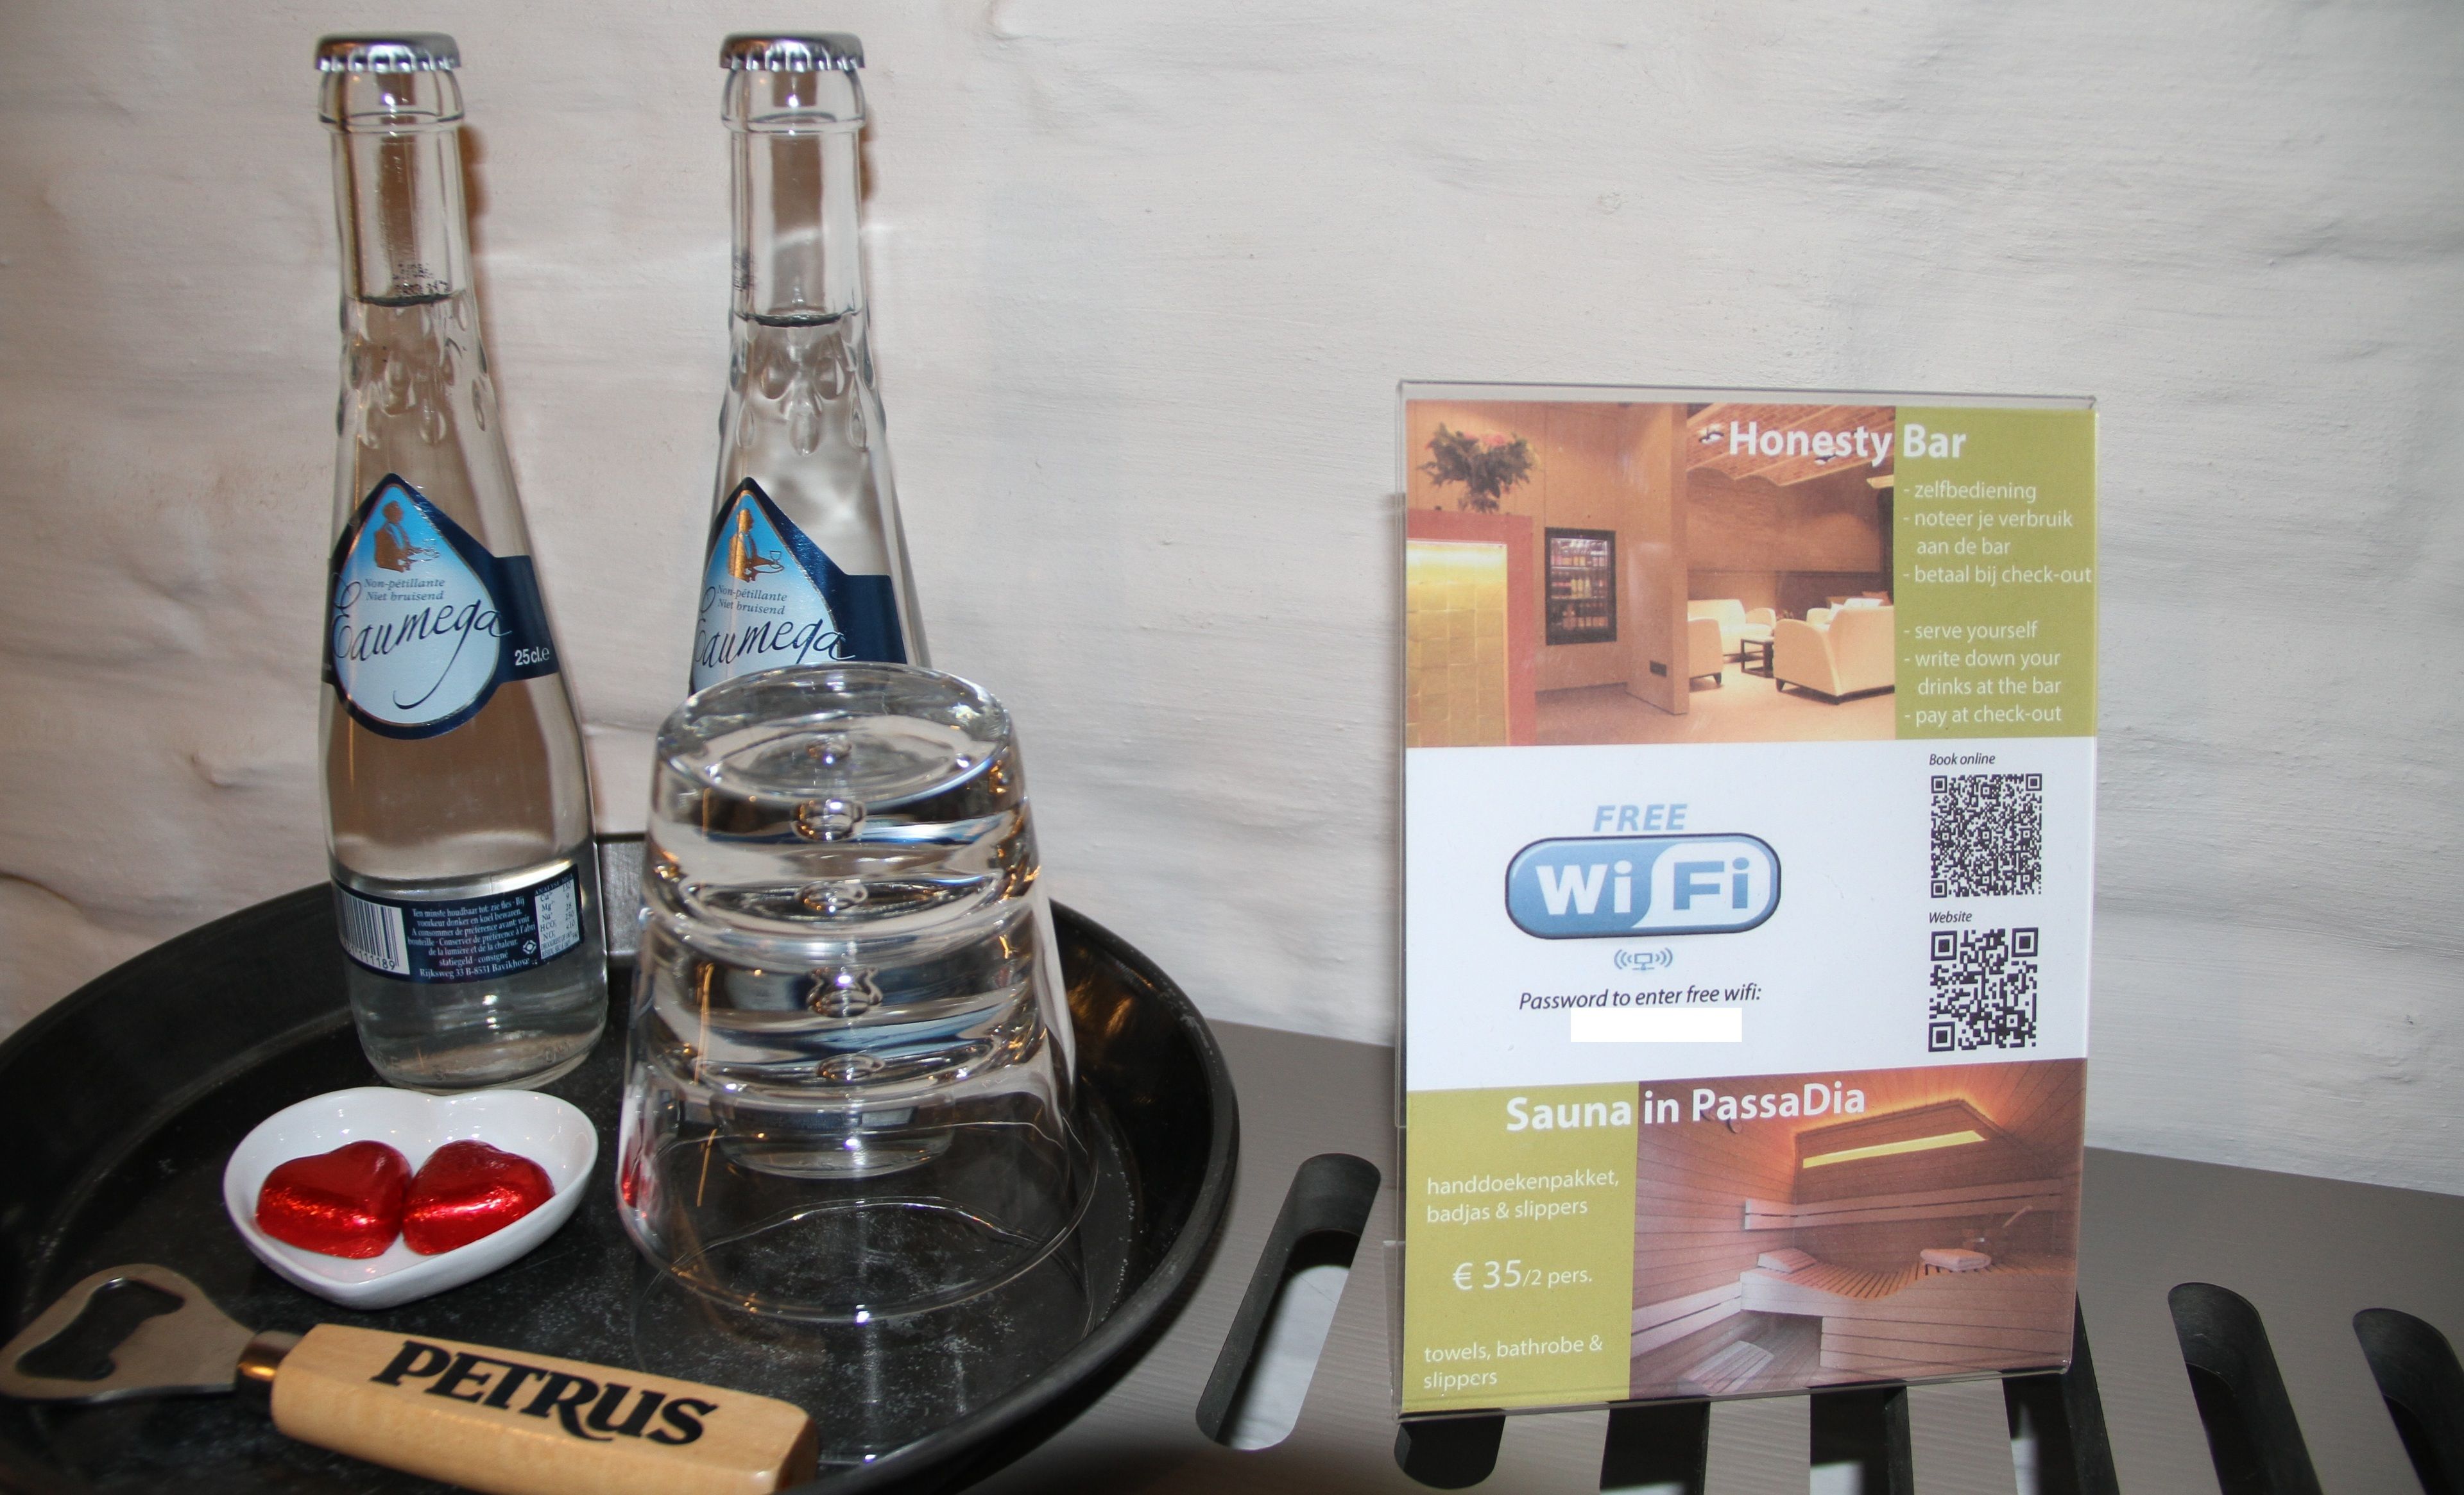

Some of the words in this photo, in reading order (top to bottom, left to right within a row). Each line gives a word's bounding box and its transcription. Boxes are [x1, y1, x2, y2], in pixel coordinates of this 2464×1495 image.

[1729, 421, 1892, 467] Honesty
[1903, 424, 1966, 459] Bar
[1915, 480, 2036, 503] zelfbediening
[1915, 511, 1973, 527] noteer
[1976, 510, 1993, 531] je
[1999, 509, 2073, 527] verbruik
[1917, 542, 1948, 554] aan
[1955, 537, 1976, 554] de
[1982, 537, 2010, 554] bar
[364, 578, 445, 590] Non-pétillante
[1915, 565, 1969, 583] betaal
[1976, 565, 1996, 586] bij
[2002, 565, 2092, 583] check-out
[366, 591, 387, 601] Niet
[391, 590, 444, 601] bruisend
[717, 585, 787, 602] Non-pétillante
[717, 598, 733, 610] Niet
[736, 601, 785, 615] bruisend
[1915, 625, 1962, 639] serve
[1967, 620, 2038, 643] yourself
[1915, 651, 1960, 667] write
[1965, 649, 2015, 667] down
[2021, 653, 2060, 671] your
[1918, 678, 1971, 695] drinks
[1976, 679, 1993, 694] at
[1998, 677, 2026, 694] the
[2033, 677, 2062, 694] bar
[1916, 710, 1946, 728] pay
[1952, 707, 1969, 722] at
[1974, 704, 2062, 722] check-out
[1929, 753, 1958, 765] Book
[1960, 753, 1996, 765] online
[1593, 803, 1688, 832] FREE
[412, 909, 424, 918] Ten
[425, 909, 445, 918] minste
[447, 907, 478, 917] houdbaar
[490, 902, 500, 911] zie
[501, 900, 511, 909] fles
[516, 896, 524, 907] Bij
[1929, 910, 1972, 924] Website
[417, 918, 445, 927] voorkeur
[447, 917, 470, 927] donker
[470, 916, 478, 924] en
[479, 912, 493, 923] koel
[418, 928, 453, 937] consommer
[455, 928, 463, 936] de
[518, 916, 530, 926] voir
[428, 947, 436, 956] de
[437, 946, 443, 955] la
[445, 944, 469, 955] lumière
[470, 944, 477, 954] et
[478, 943, 486, 952] de
[487, 941, 493, 951] la
[439, 936, 472, 946] Conserver
[473, 934, 481, 943] de
[439, 956, 473, 968] statiegeld
[478, 951, 508, 964] consigné
[420, 968, 454, 979] Rijksweg
[456, 968, 464, 977] 33
[466, 964, 490, 976] B-8531
[1519, 989, 1608, 1010] Password
[1613, 990, 1630, 1007] to
[1636, 988, 1684, 1006] enter
[1686, 984, 1720, 1004] free
[1724, 982, 1761, 1002] wifi:
[1507, 1097, 1631, 1131] Sauna
[1644, 1090, 1679, 1124] in
[1692, 1082, 1865, 1122] PassaDia
[1428, 1169, 1619, 1195] handdoekenpakket,
[1427, 1204, 1490, 1225] badjas
[1496, 1202, 1509, 1219] &
[1515, 1200, 1588, 1220] slippers
[1453, 1262, 1473, 1290] €
[1548, 1269, 1593, 1288] pers.
[1425, 1342, 1491, 1363] towels,
[1497, 1336, 1584, 1358] bathrobe
[1589, 1335, 1603, 1351] &
[1424, 1372, 1498, 1391] slippers
[369, 1339, 718, 1446] PETRUS
